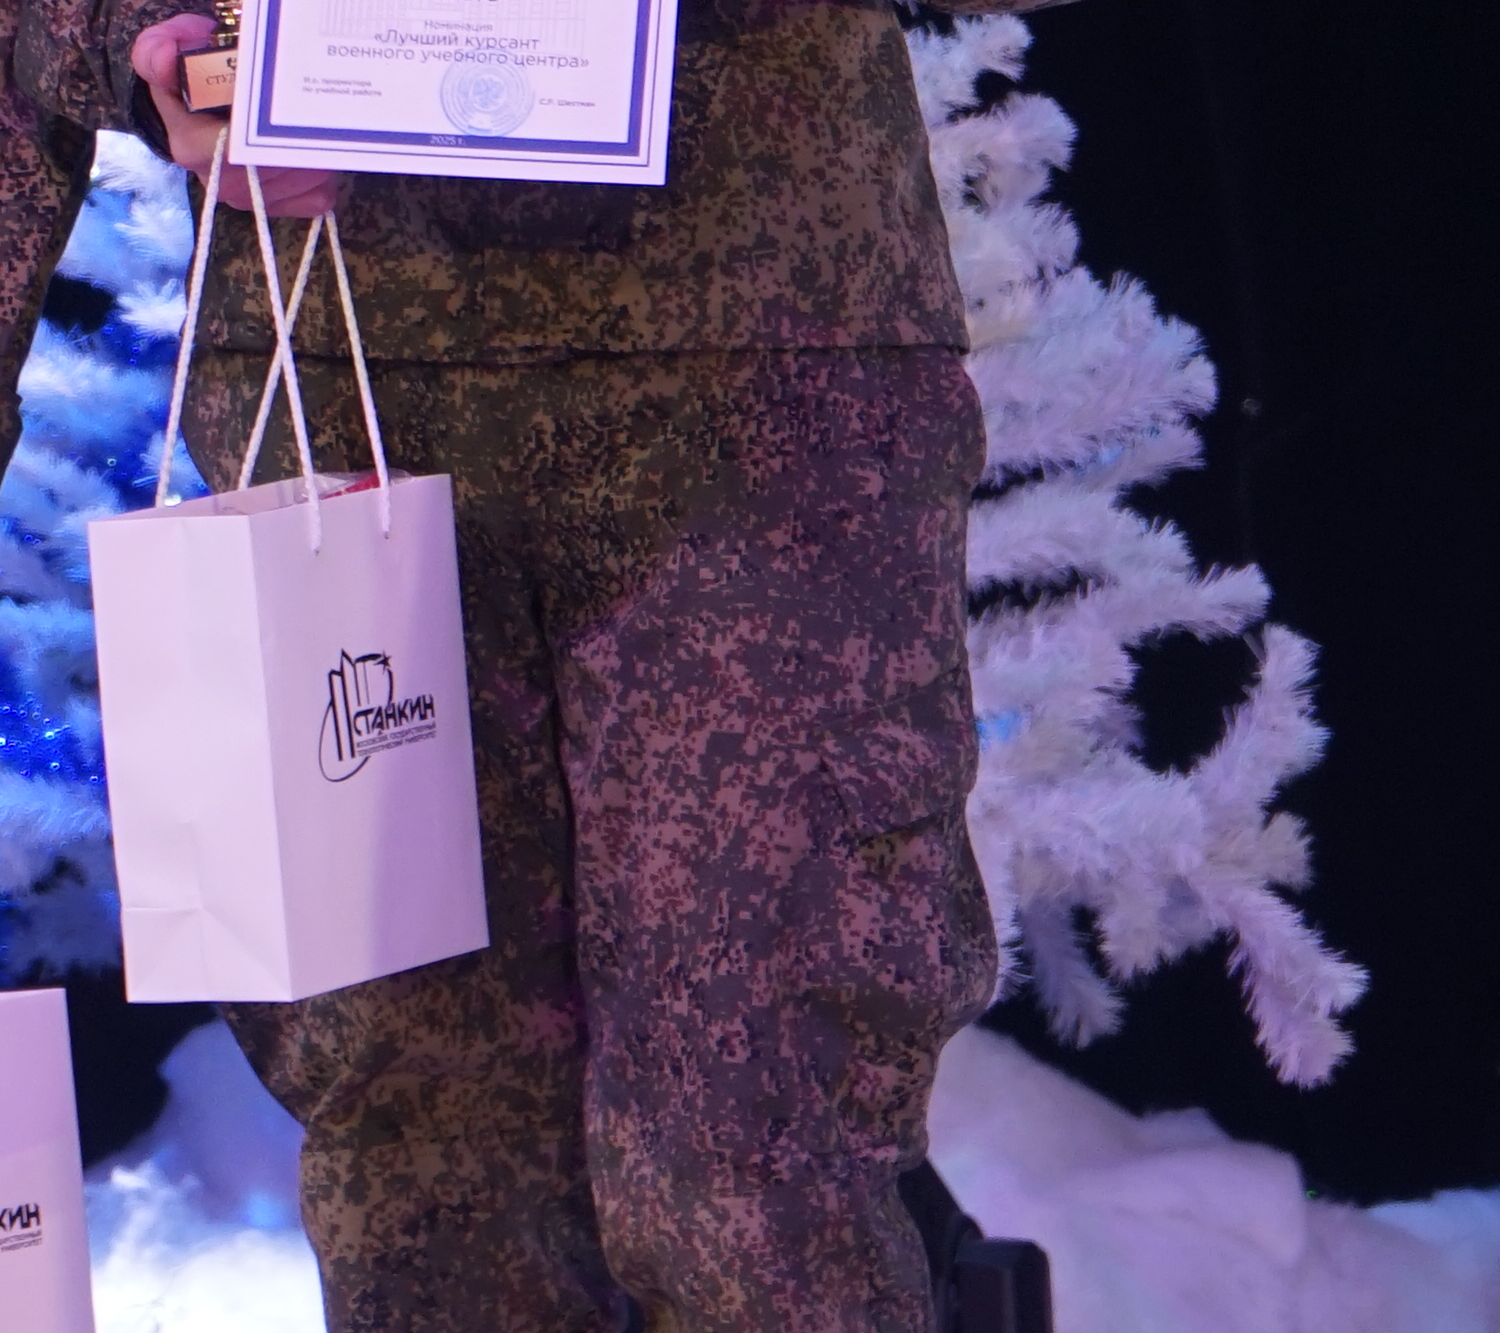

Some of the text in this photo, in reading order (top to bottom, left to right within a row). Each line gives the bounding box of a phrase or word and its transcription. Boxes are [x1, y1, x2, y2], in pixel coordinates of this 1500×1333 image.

[374, 28, 539, 51] «Лучший курсант
[327, 44, 589, 69] военного учебного центра»
[354, 694, 435, 736] СТАНКИН
